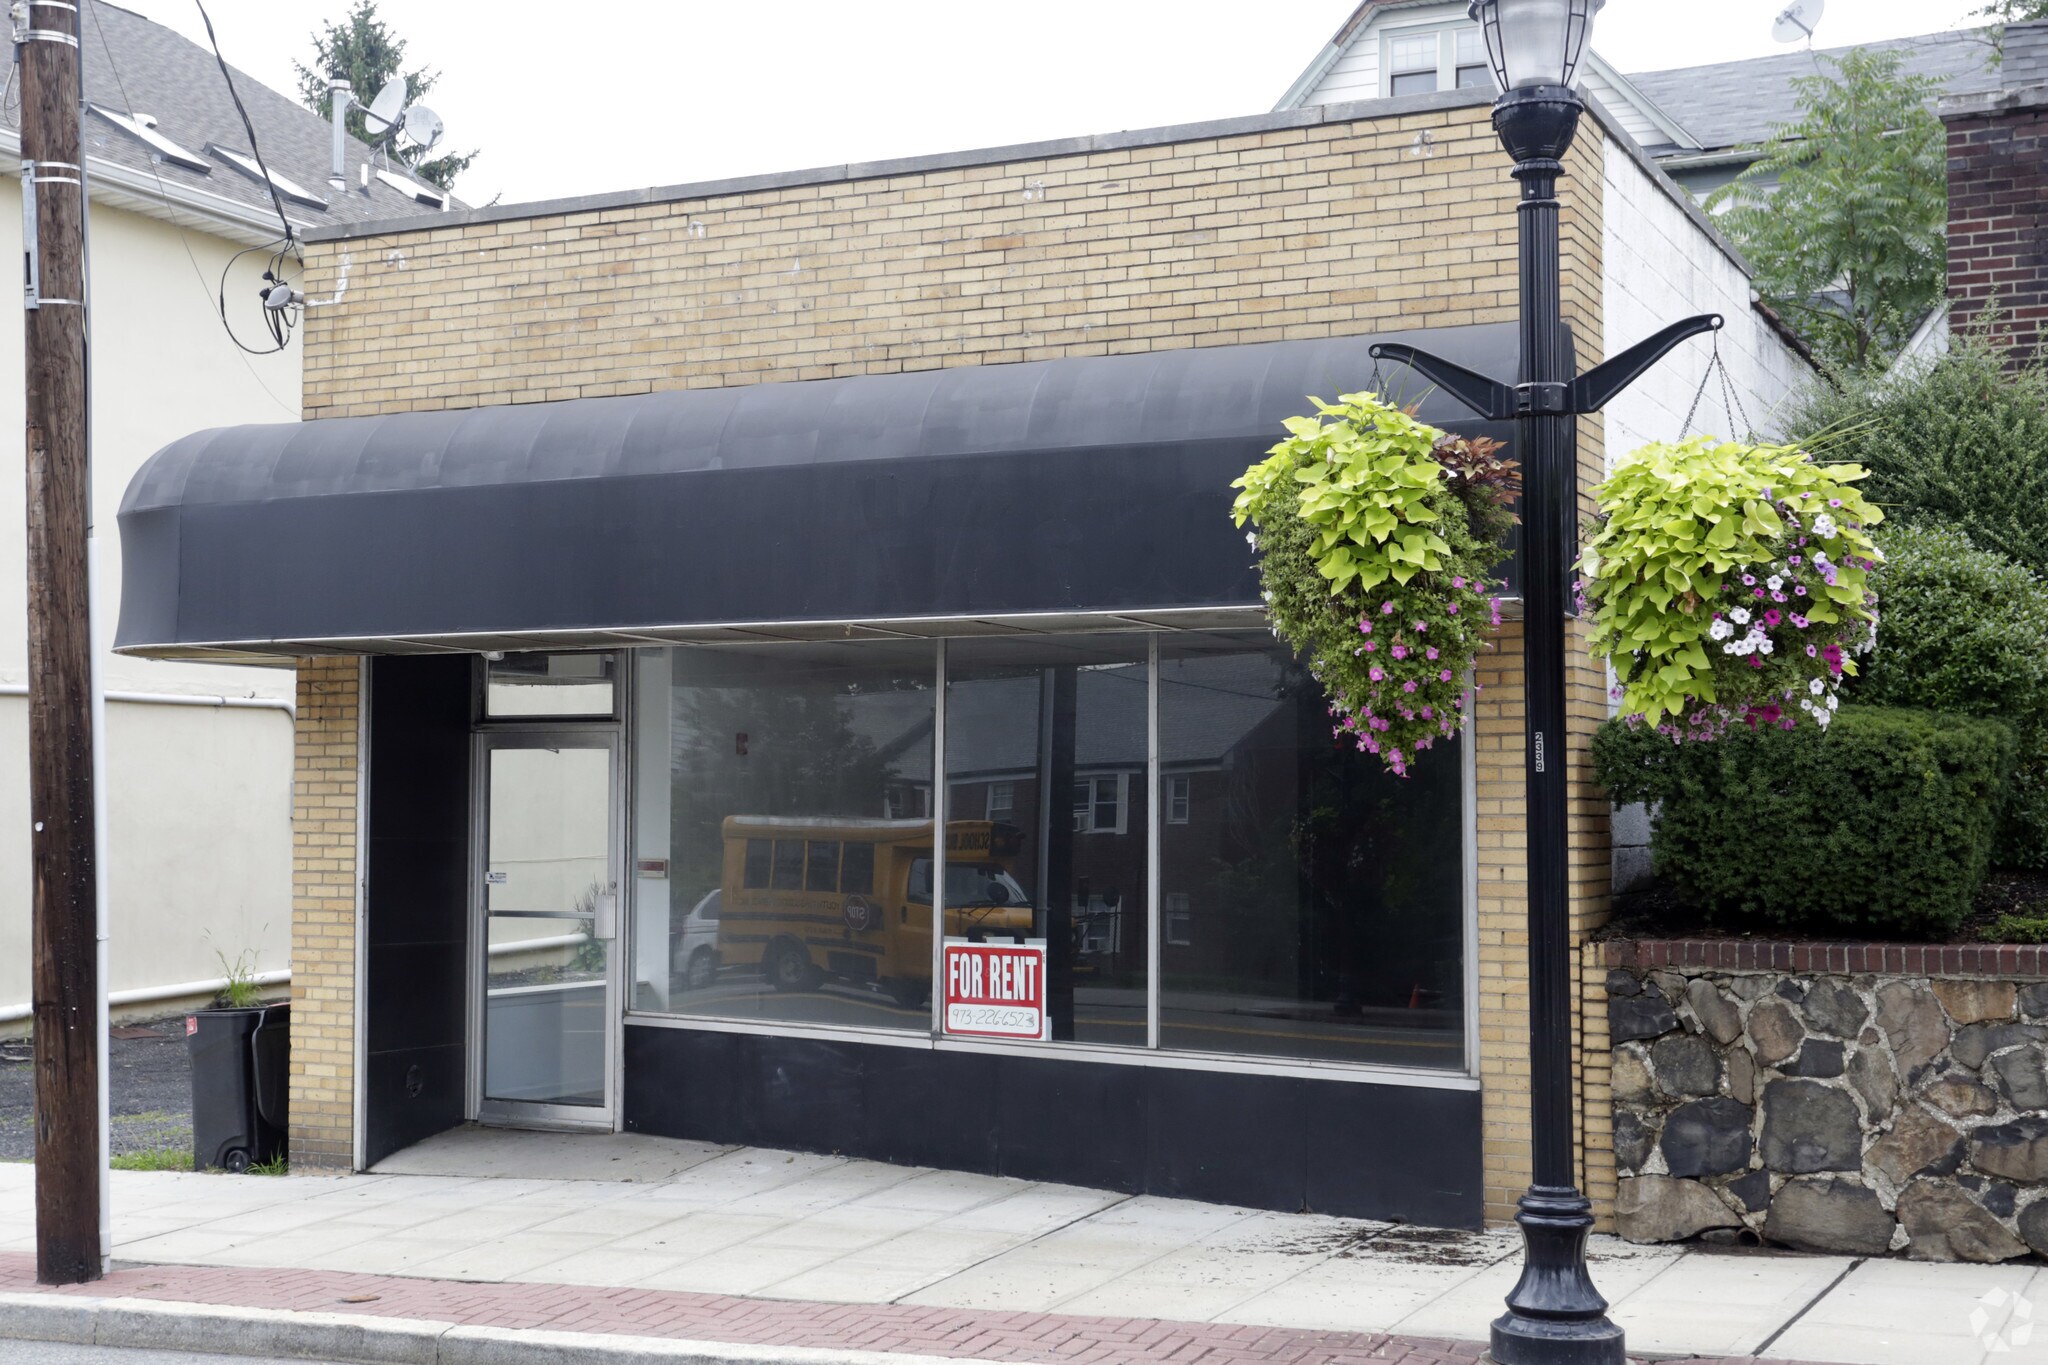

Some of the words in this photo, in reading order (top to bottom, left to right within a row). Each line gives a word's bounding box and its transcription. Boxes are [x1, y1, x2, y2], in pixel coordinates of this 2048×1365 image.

[1535, 732, 1543, 771] 2339
[949, 952, 983, 998] FOR
[989, 954, 1038, 1001] RENT
[952, 1008, 1036, 1028] 973-226-6523
